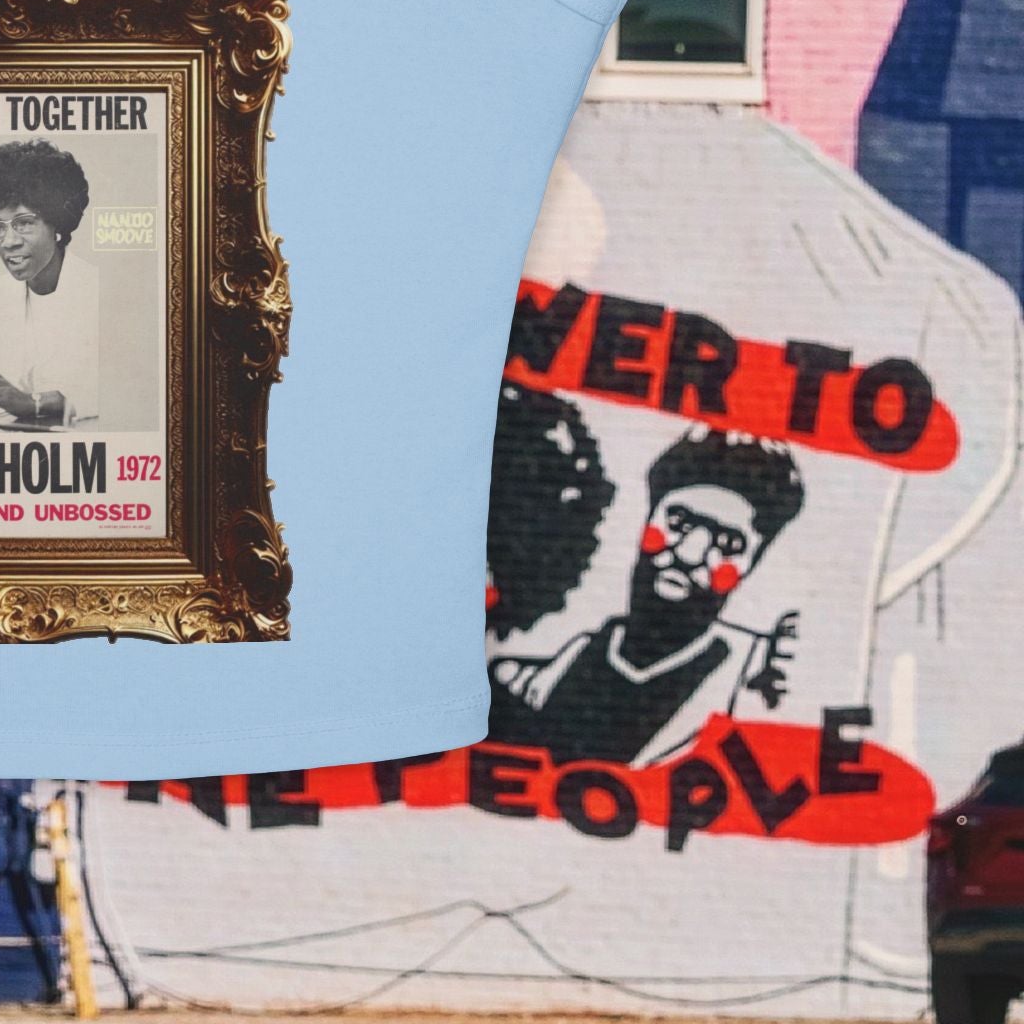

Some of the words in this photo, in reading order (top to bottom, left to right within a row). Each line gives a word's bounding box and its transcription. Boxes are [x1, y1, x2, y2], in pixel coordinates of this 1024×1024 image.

[6, 95, 148, 131] TOGETHER
[504, 281, 738, 416] WER
[785, 338, 934, 455] TO
[117, 455, 162, 481] 1972
[34, 504, 152, 522] UNBOSSED
